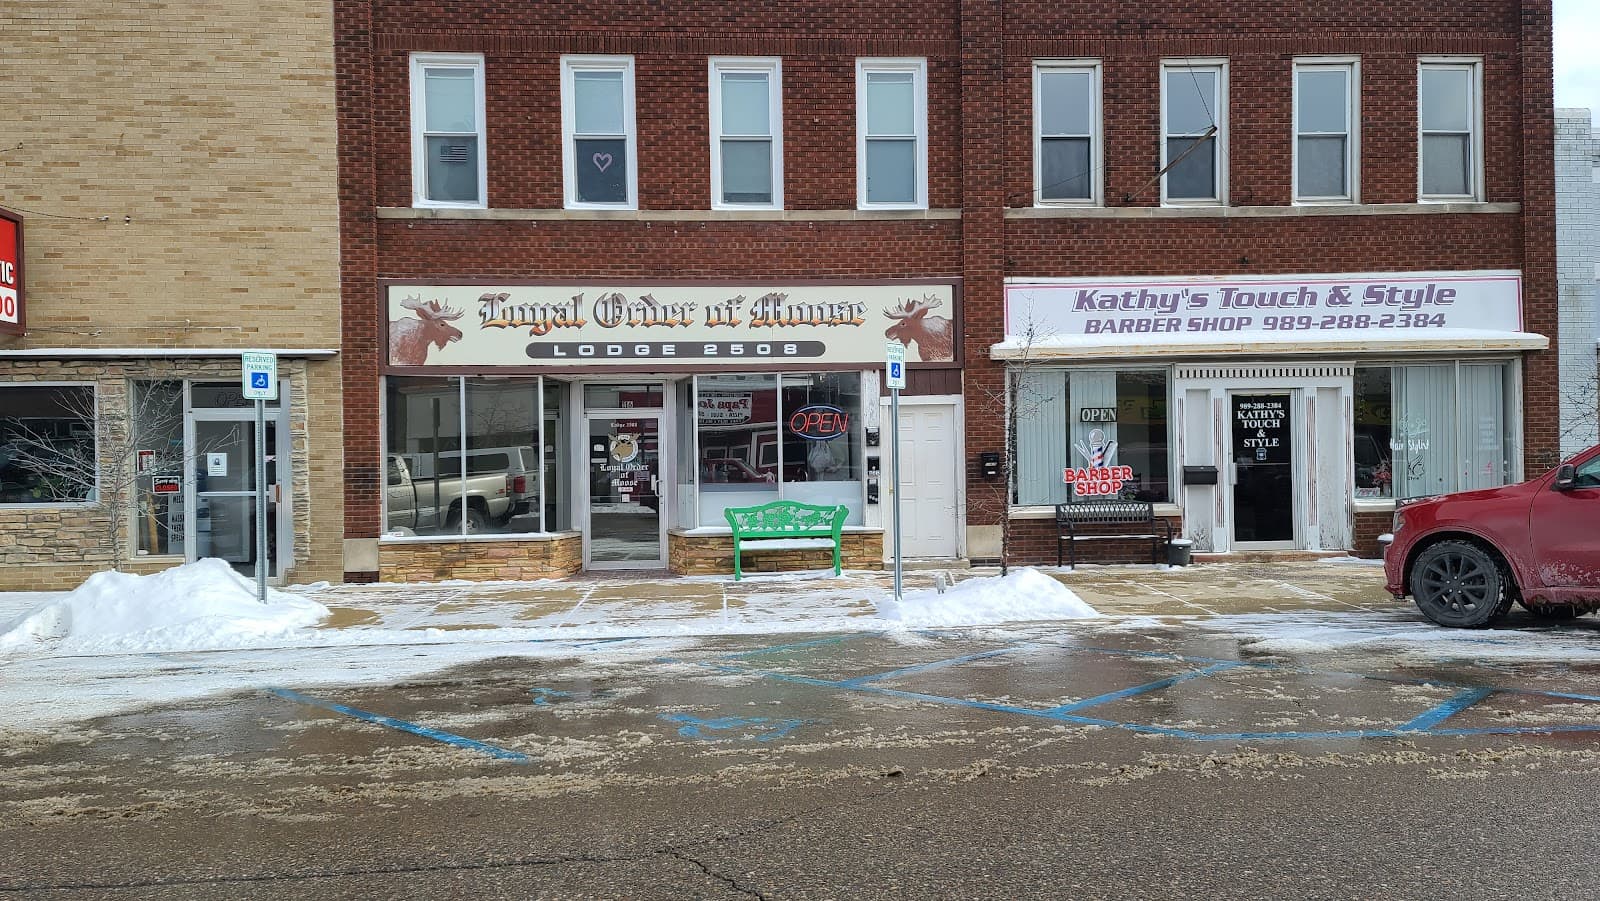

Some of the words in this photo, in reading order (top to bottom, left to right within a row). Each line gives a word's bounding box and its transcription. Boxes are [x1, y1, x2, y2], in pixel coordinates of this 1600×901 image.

[1072, 288, 1209, 315] Kathy's
[1217, 285, 1318, 310] Touch
[1326, 285, 1353, 309] &
[1363, 283, 1457, 312] Style
[478, 292, 587, 337] Loyal
[593, 292, 698, 329] Order
[704, 294, 746, 328] of
[749, 292, 868, 330] Moose
[1084, 318, 1182, 334] BARBER
[1187, 316, 1252, 332] SHOP
[1262, 312, 1446, 331] 989-288-2384
[553, 343, 677, 357] LODGE
[702, 343, 799, 356] 2508
[244, 355, 274, 363] RESERVED
[1081, 408, 1117, 422] OPEN
[1237, 409, 1286, 419] KATHY'S
[790, 412, 848, 433] OPEN
[1241, 419, 1281, 428] TOUCH
[1256, 429, 1266, 437] &
[1243, 438, 1280, 447] STYLE
[1389, 438, 1404, 451] Hair
[1407, 438, 1430, 454] Stylist
[600, 463, 624, 473] Loyal
[625, 463, 649, 471] Order
[620, 471, 630, 479] of
[1064, 466, 1133, 482] BARBER
[1076, 481, 1122, 495] SHOP
